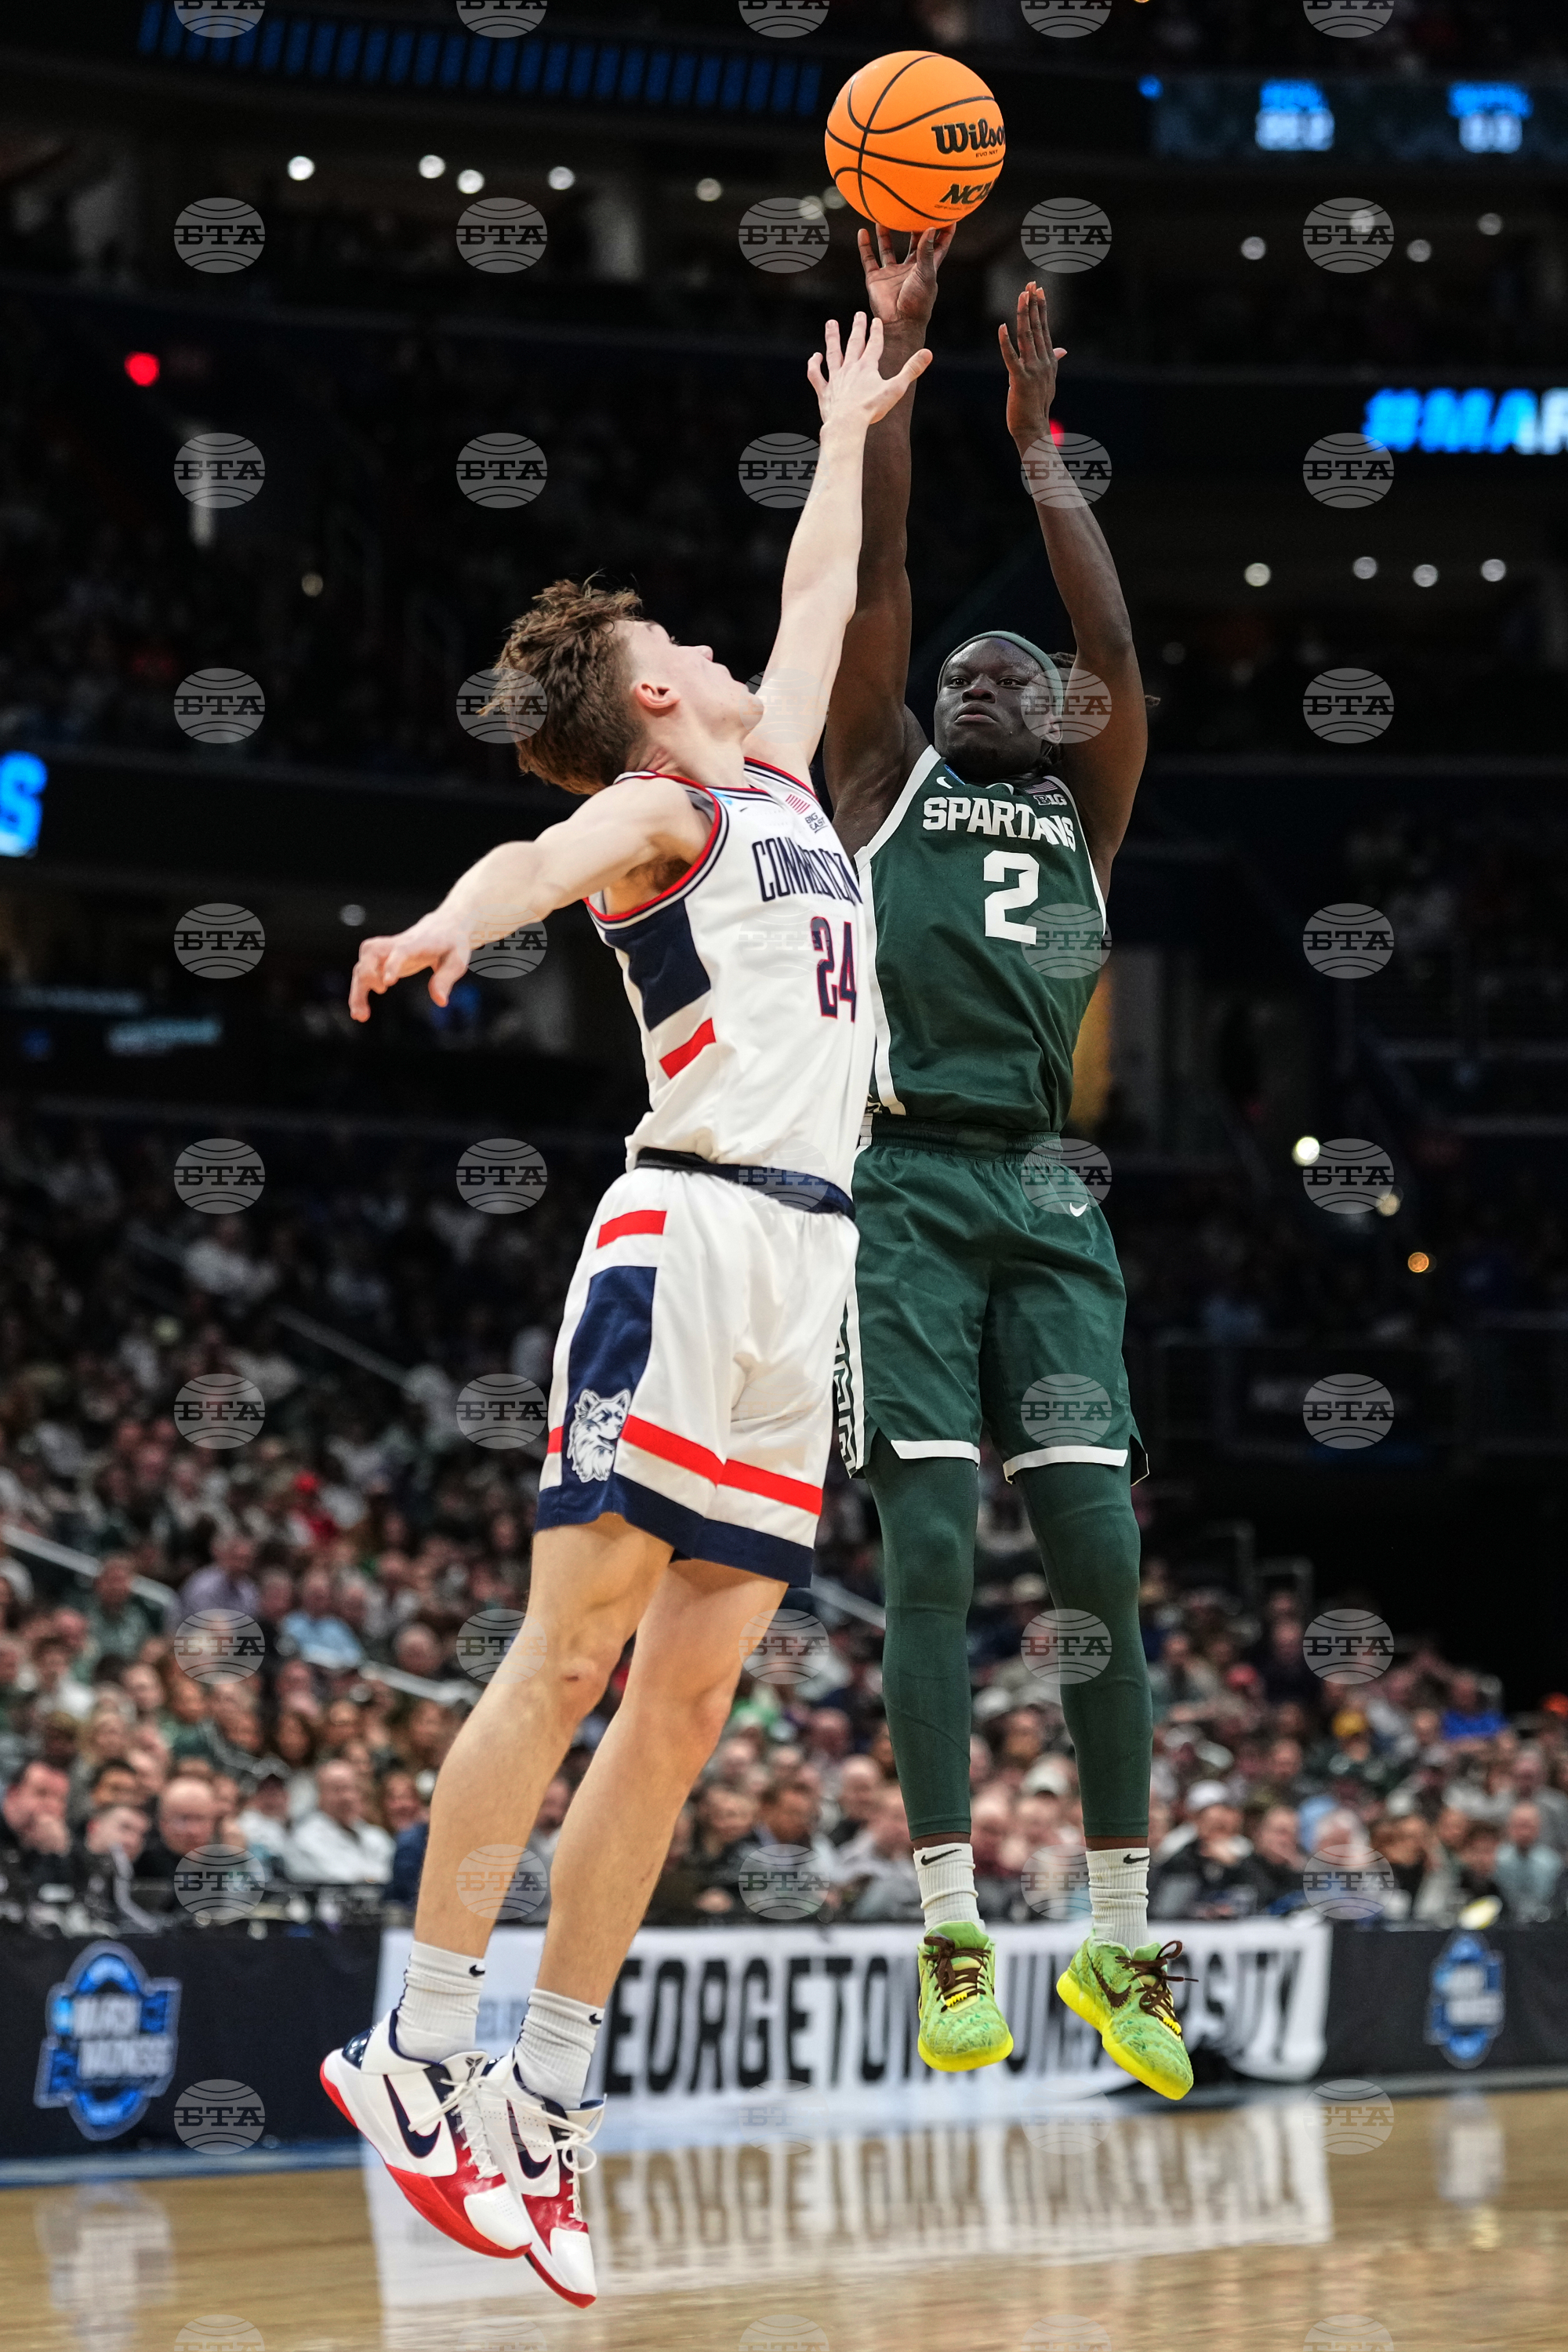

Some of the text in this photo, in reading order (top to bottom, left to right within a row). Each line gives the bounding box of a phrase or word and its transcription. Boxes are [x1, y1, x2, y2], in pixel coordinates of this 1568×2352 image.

[931, 118, 1005, 154] Wilso
[939, 178, 997, 205] NCA
[923, 797, 1076, 852] SPARTANS
[984, 850, 1040, 946] 2
[811, 916, 857, 1023] 24
